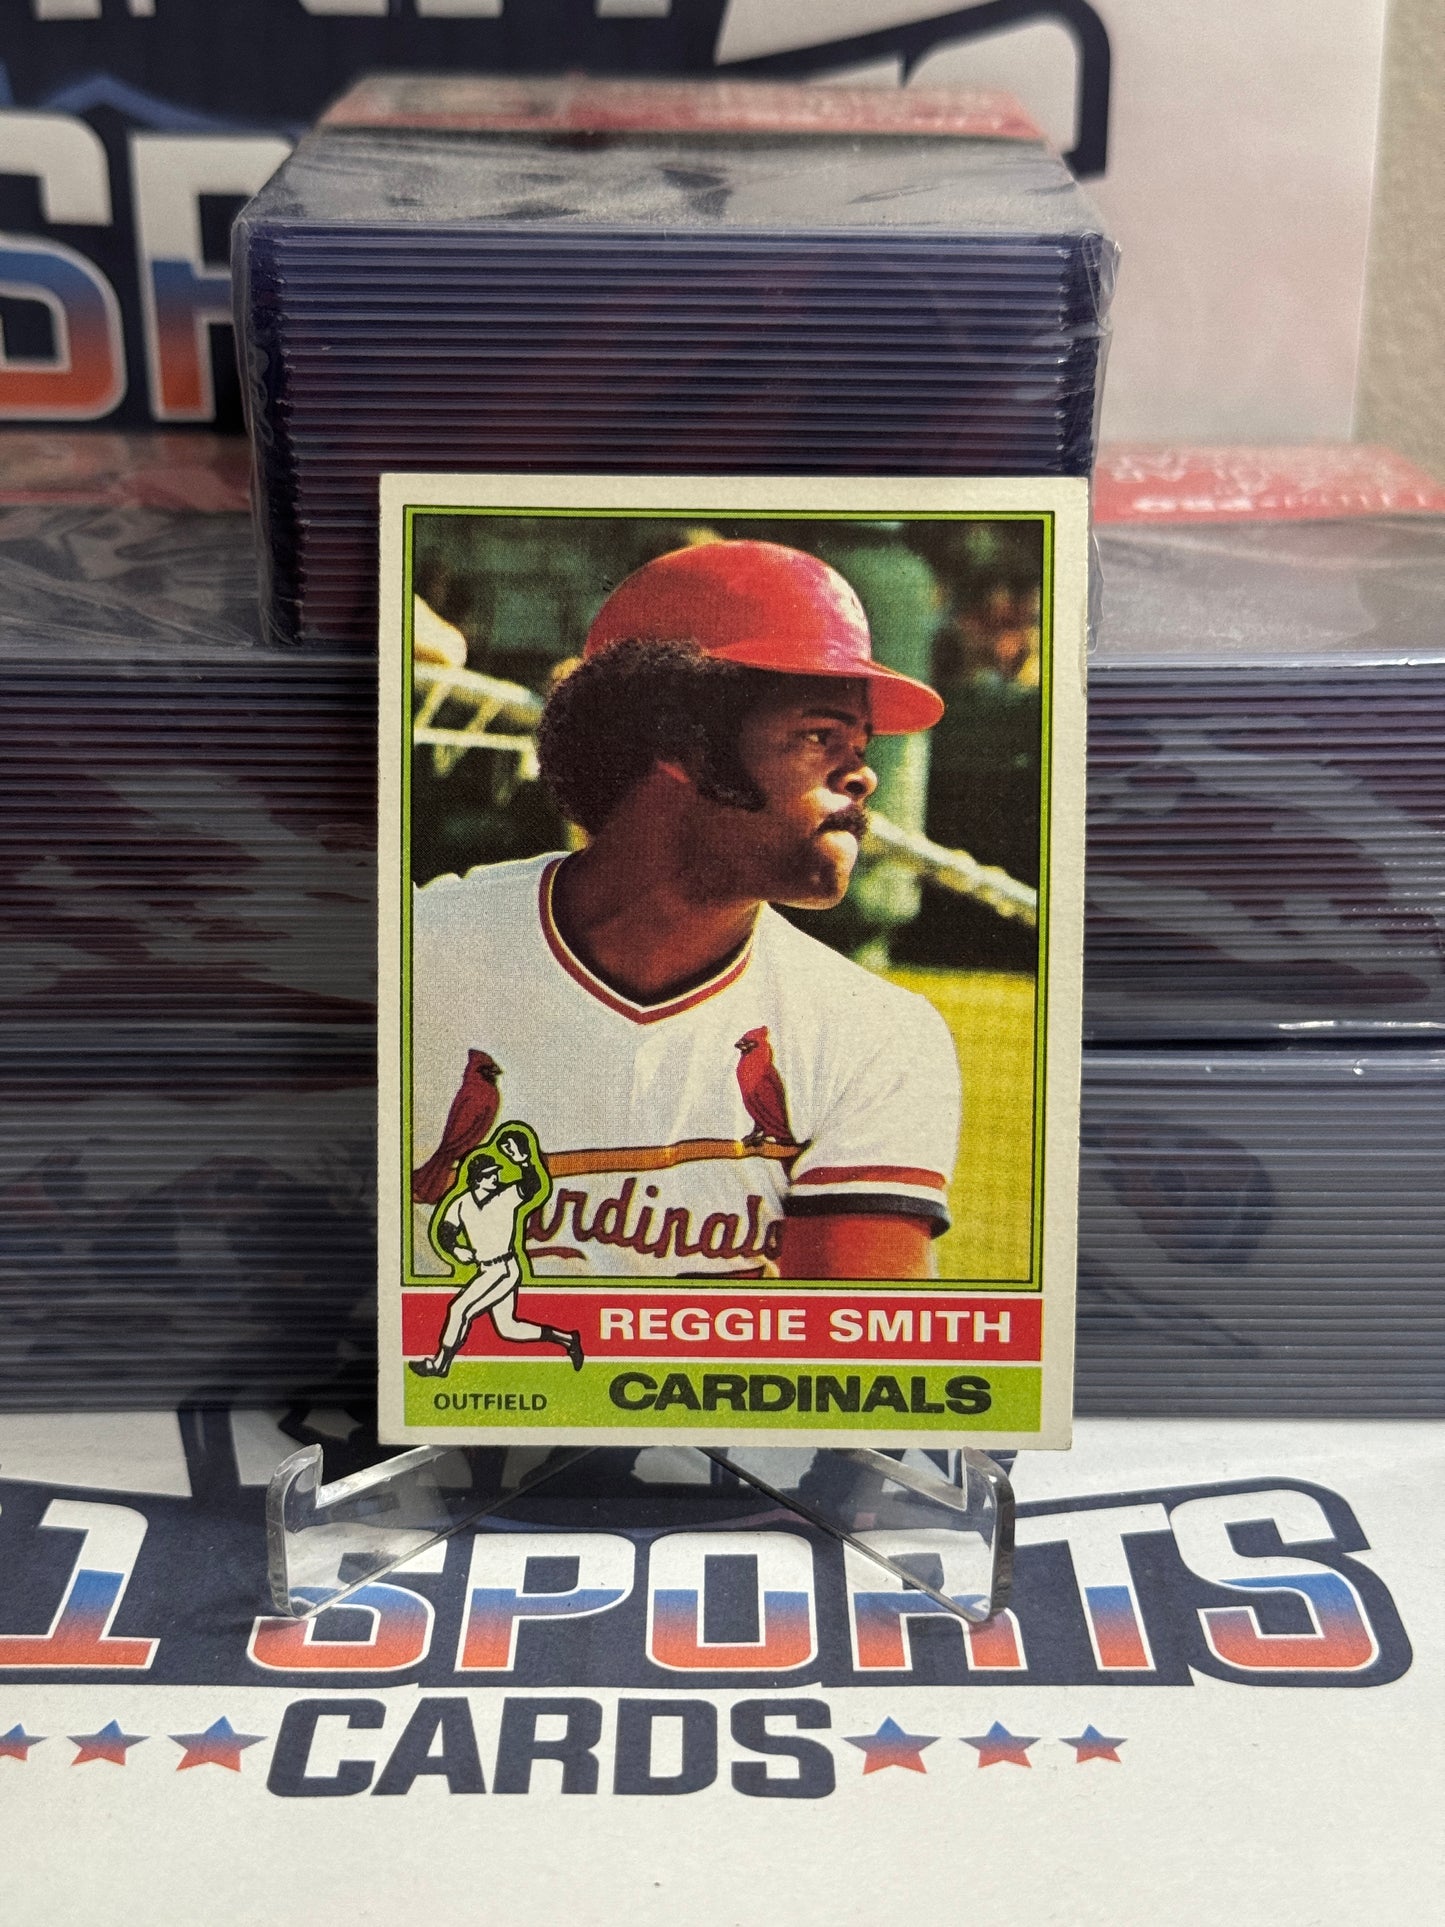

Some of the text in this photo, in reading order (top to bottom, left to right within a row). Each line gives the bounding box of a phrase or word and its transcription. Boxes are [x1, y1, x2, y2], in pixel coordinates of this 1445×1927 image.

[525, 1177, 786, 1260] ardinals
[599, 1307, 1011, 1344] REGGIE SMITH
[433, 1391, 548, 1413] OUTFIELD
[608, 1370, 992, 1415] CARDINALS
[246, 1488, 1382, 1674] SPORTS
[266, 1697, 836, 1799] CARDS
